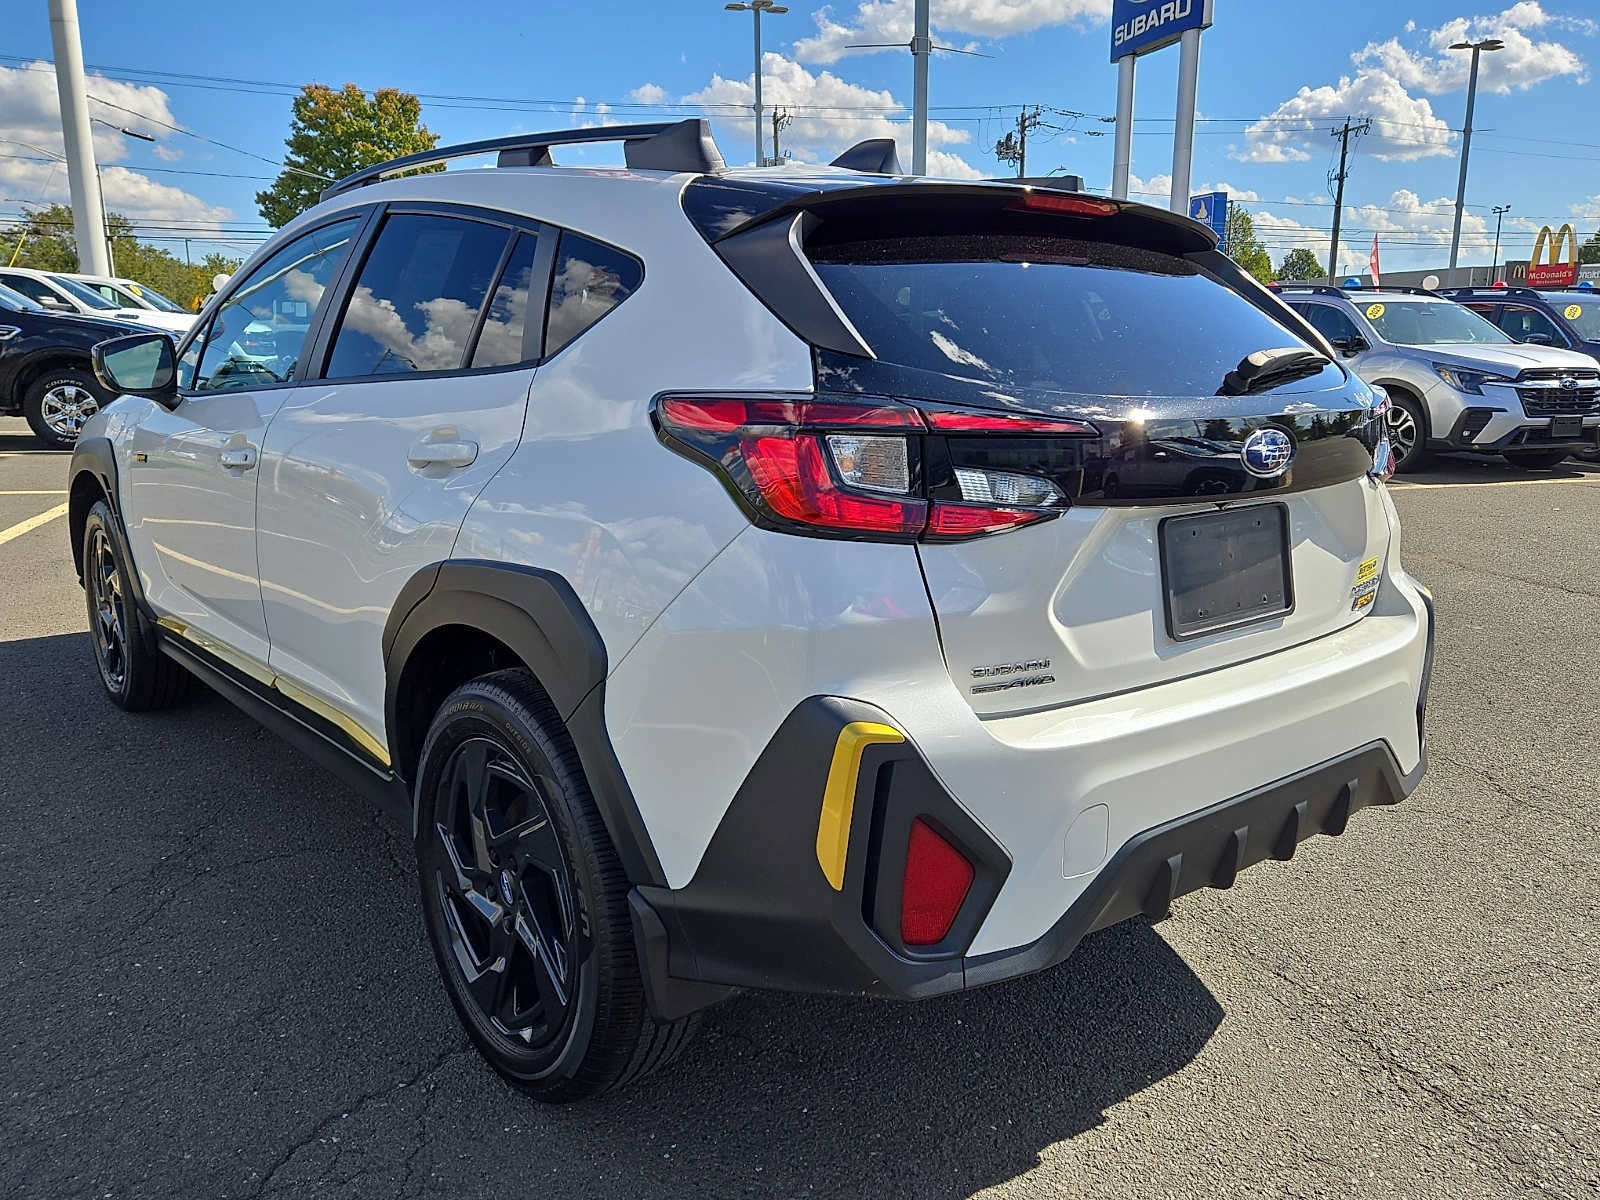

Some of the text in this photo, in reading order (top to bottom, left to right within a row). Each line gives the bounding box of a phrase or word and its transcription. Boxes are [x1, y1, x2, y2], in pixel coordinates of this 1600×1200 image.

[1114, 0, 1192, 47] SUBARU
[1528, 270, 1573, 280] McDonald's
[970, 659, 1051, 679] SUBARU
